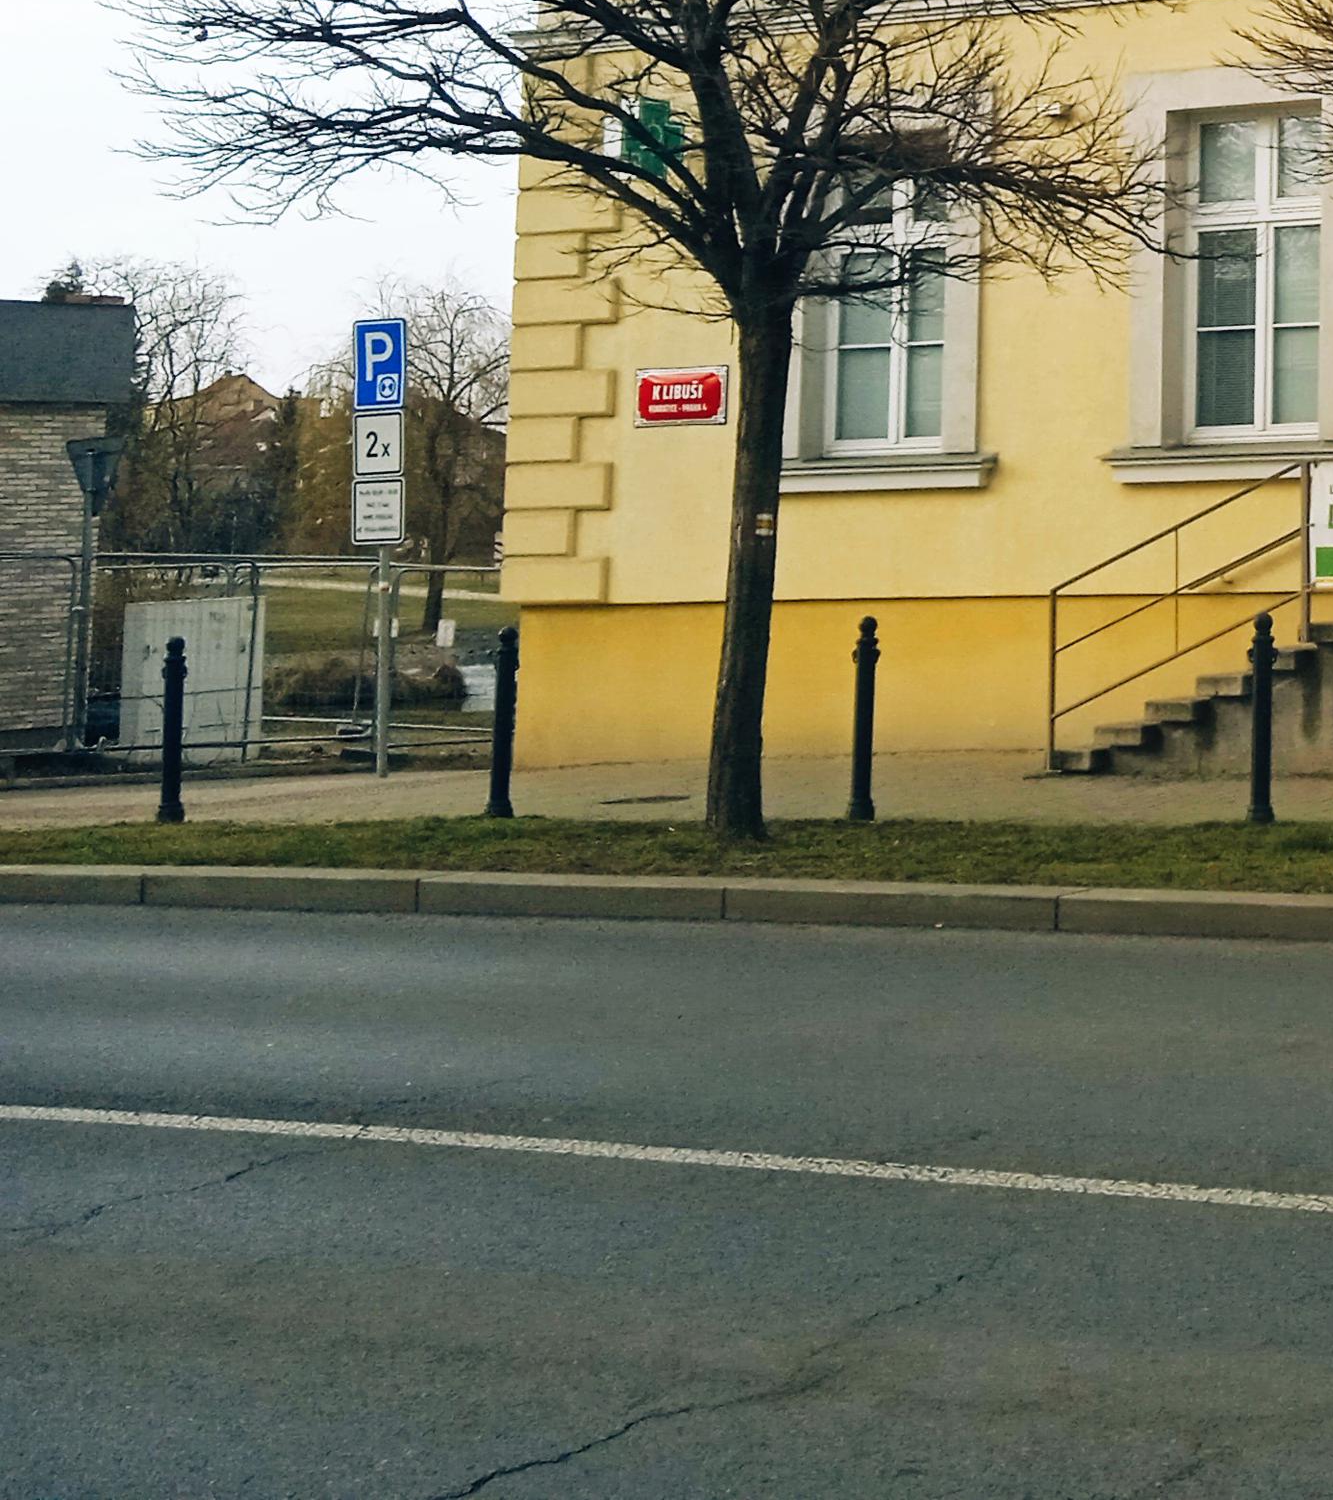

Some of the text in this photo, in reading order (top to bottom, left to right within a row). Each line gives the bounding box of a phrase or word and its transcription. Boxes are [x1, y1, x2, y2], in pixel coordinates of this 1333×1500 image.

[364, 331, 394, 382] P
[653, 381, 704, 400] K LIBUŠI
